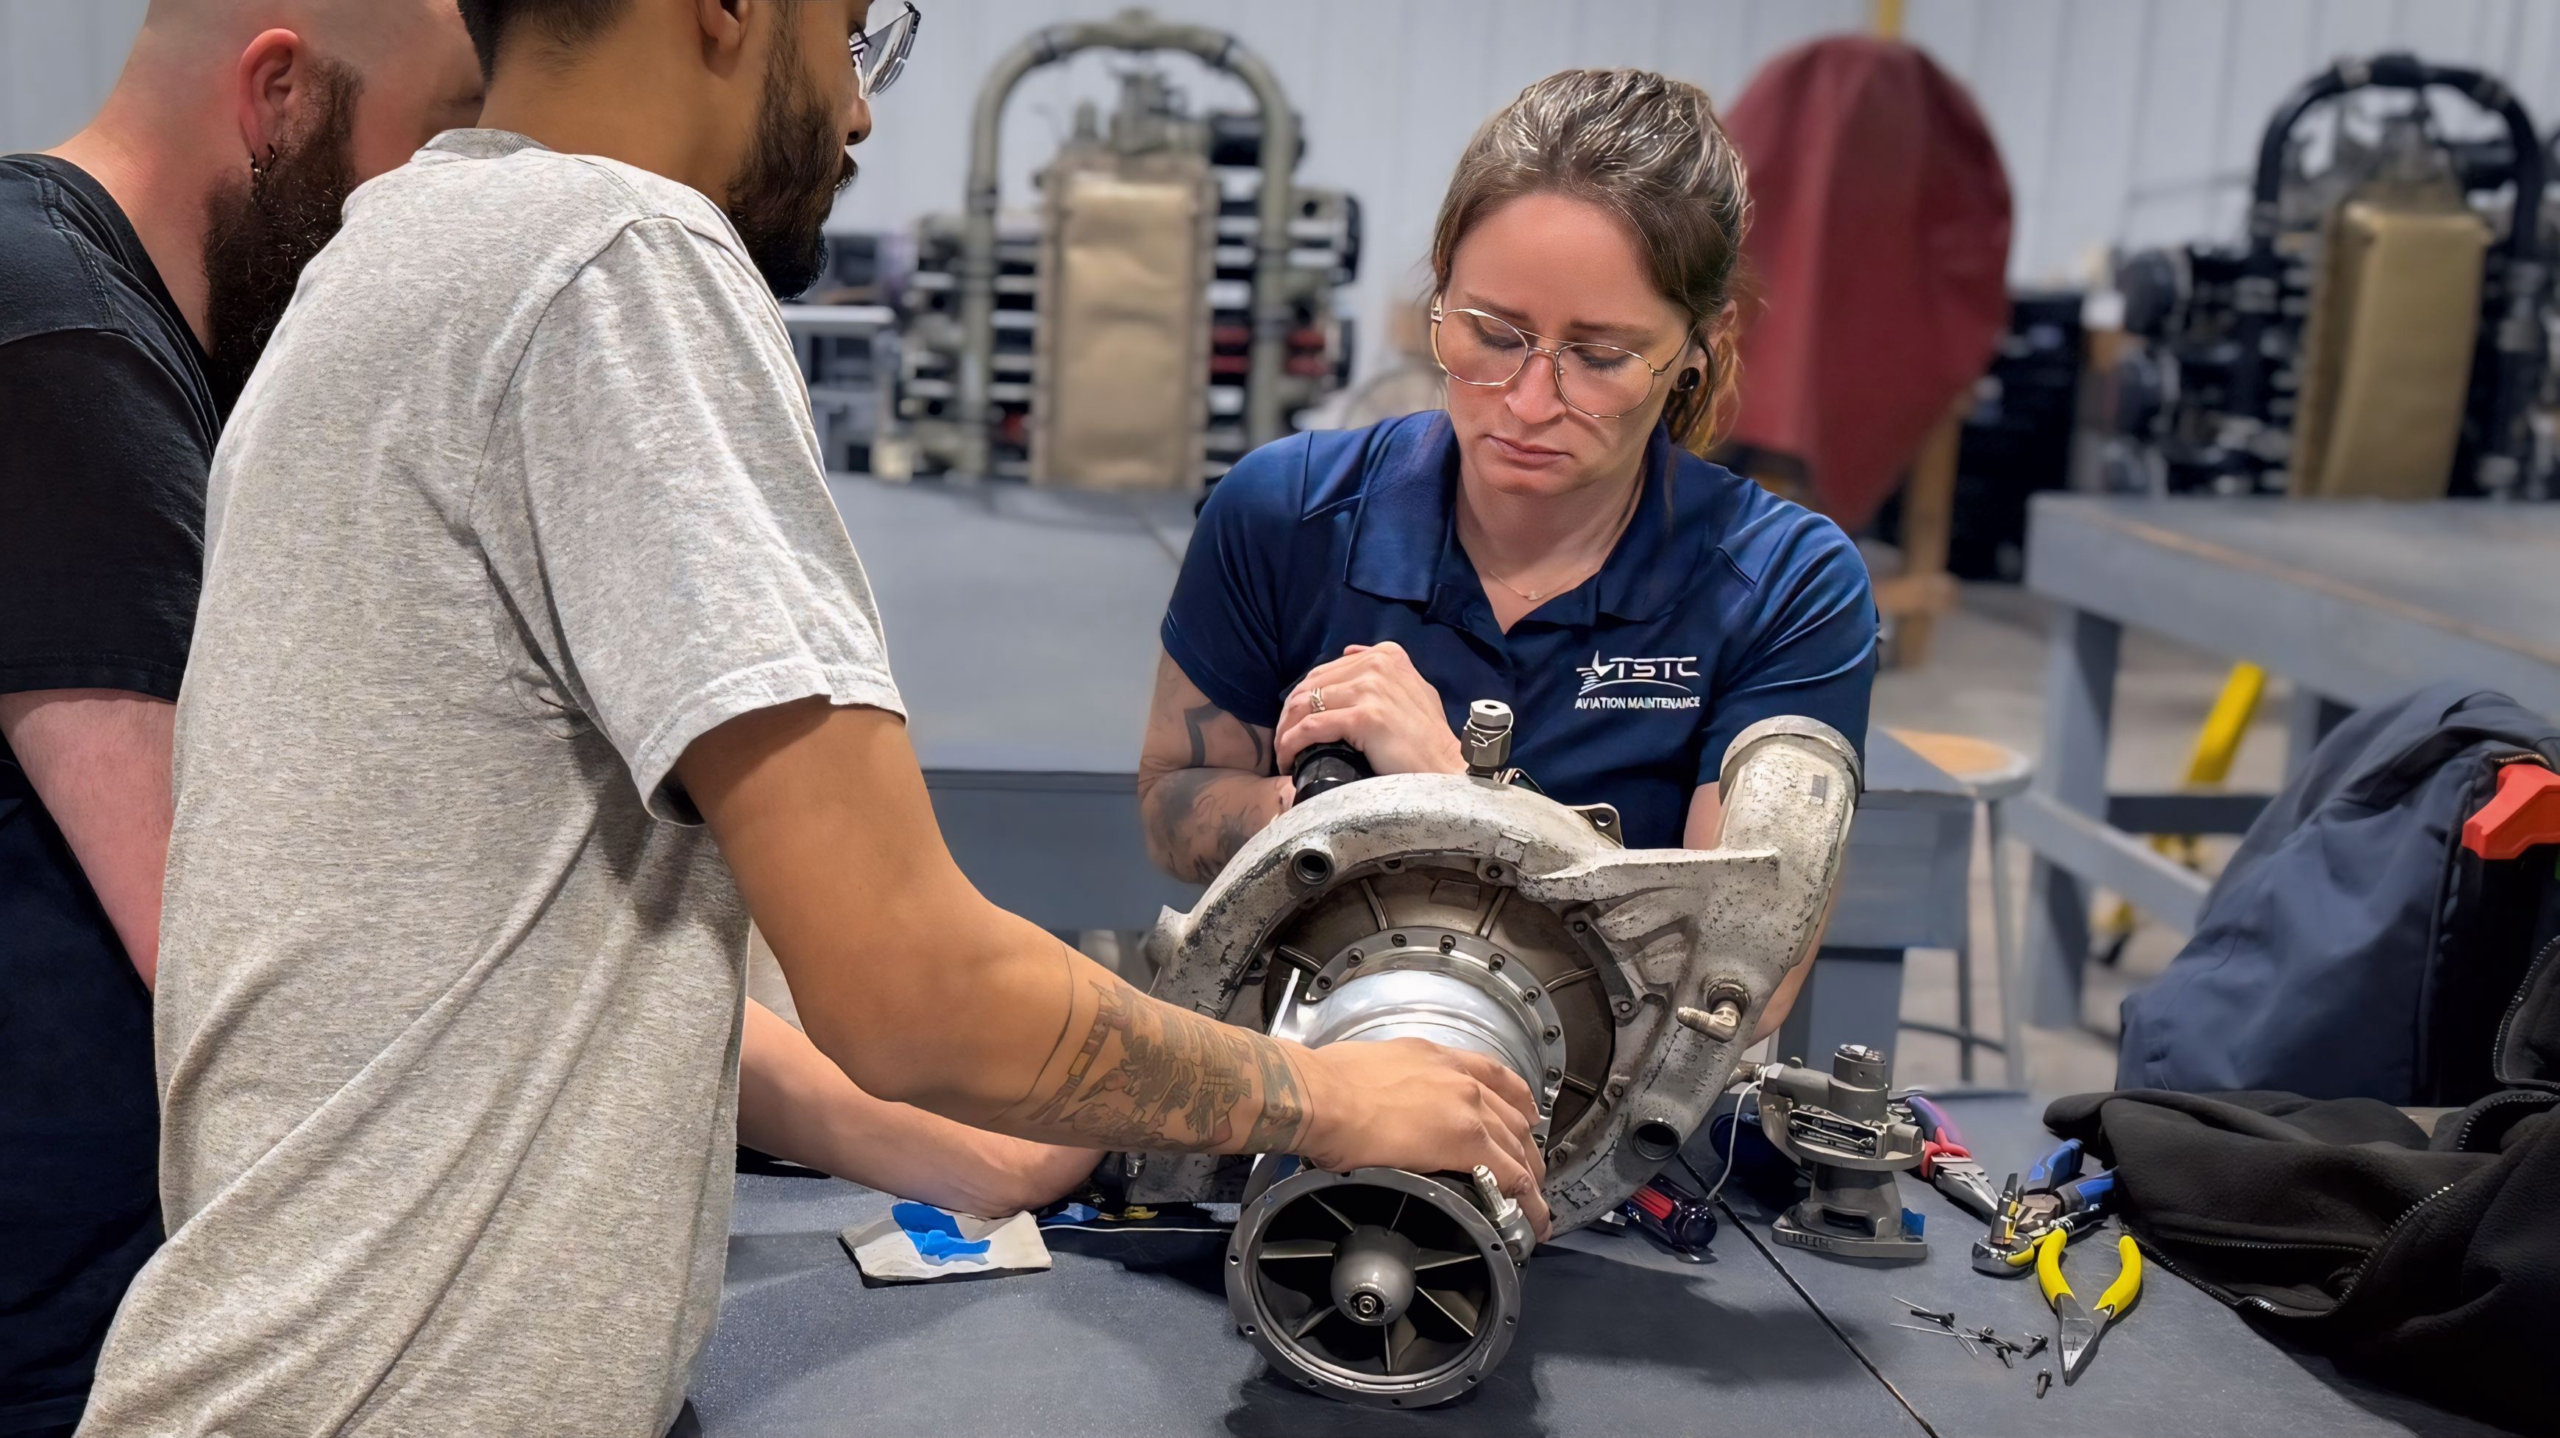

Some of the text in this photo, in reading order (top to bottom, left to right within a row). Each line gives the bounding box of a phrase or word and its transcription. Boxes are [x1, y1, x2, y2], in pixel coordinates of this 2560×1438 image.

[1609, 656, 1700, 679] TSTC
[1575, 696, 1700, 709] AVIATION MAINTENANCE
